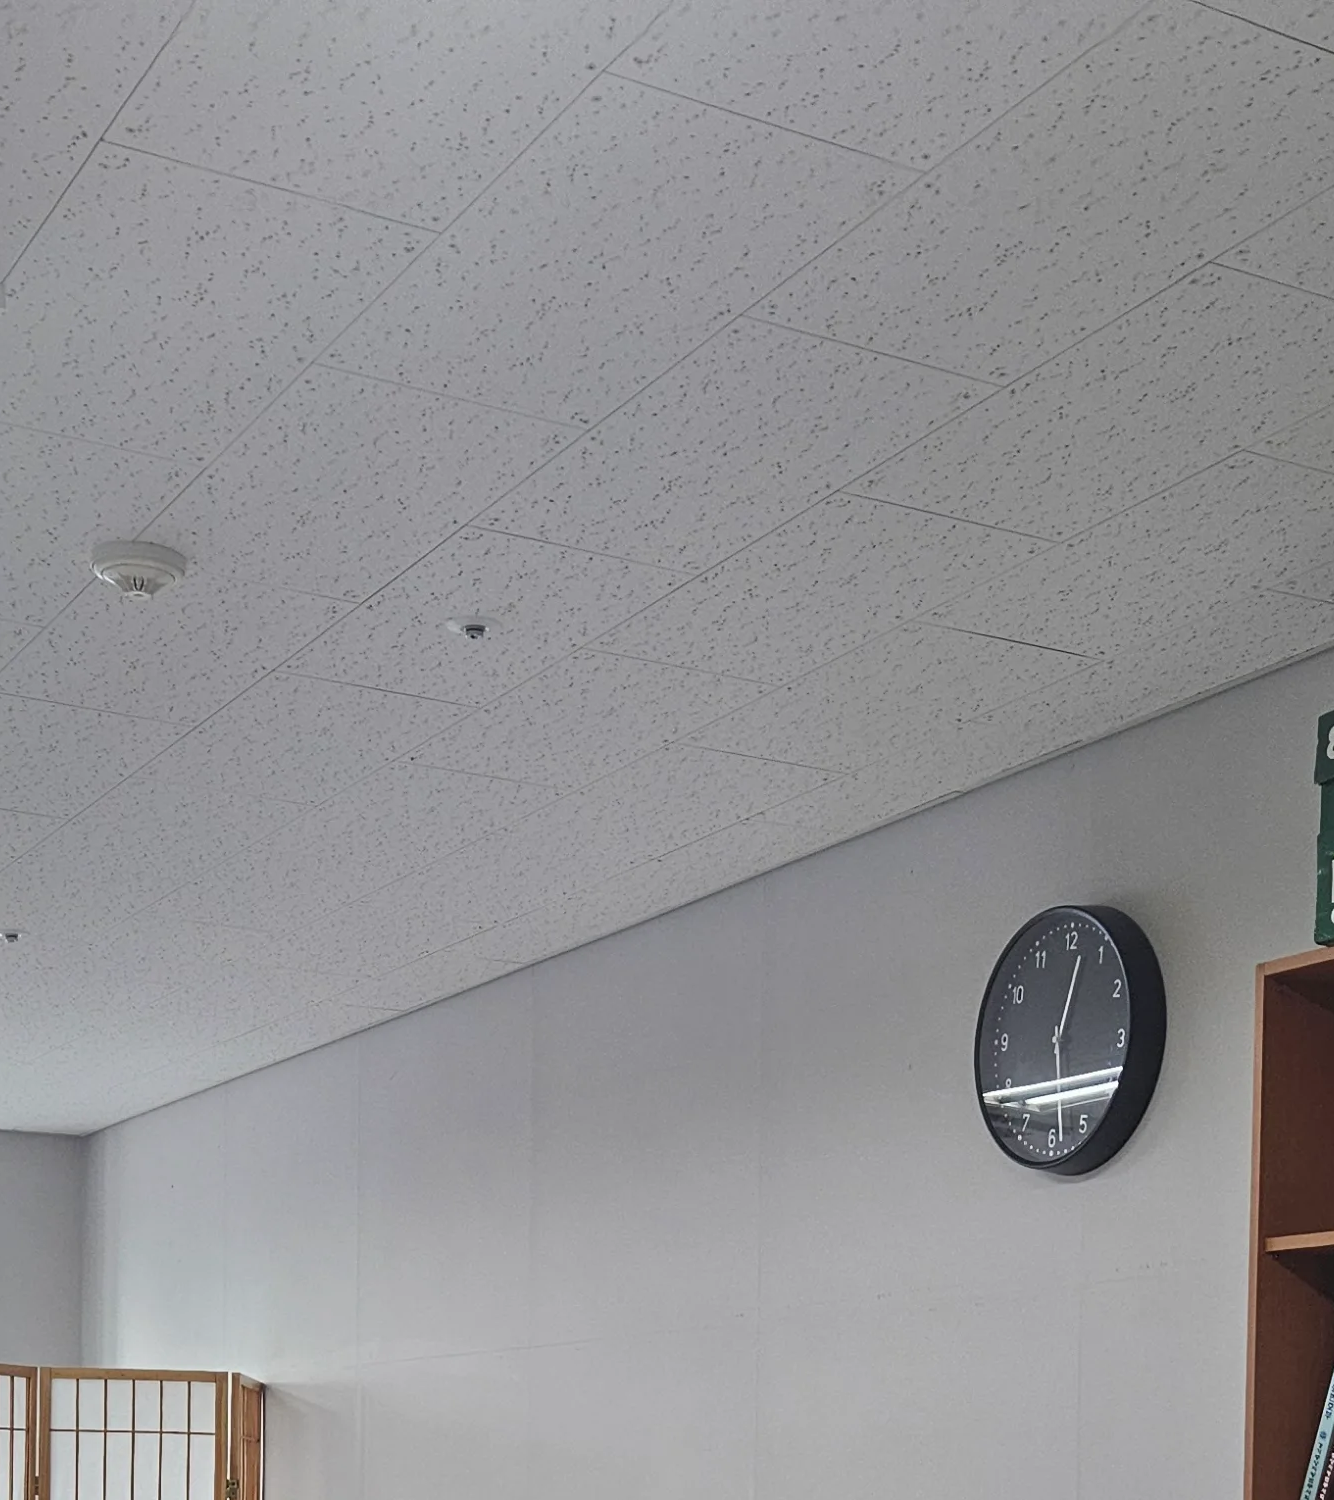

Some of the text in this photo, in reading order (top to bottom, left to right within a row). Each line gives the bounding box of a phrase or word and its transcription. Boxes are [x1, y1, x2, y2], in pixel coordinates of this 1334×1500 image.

[1065, 931, 1078, 950] 12
[1035, 950, 1046, 969] 11
[1098, 946, 1104, 964] 1
[1012, 985, 1024, 1005] 10
[1112, 979, 1122, 998] 2
[1000, 1033, 1009, 1052] 9
[1116, 1028, 1126, 1048] 3
[1022, 1113, 1030, 1132] 7
[1078, 1114, 1088, 1134] 5
[1047, 1129, 1056, 1148] 6
